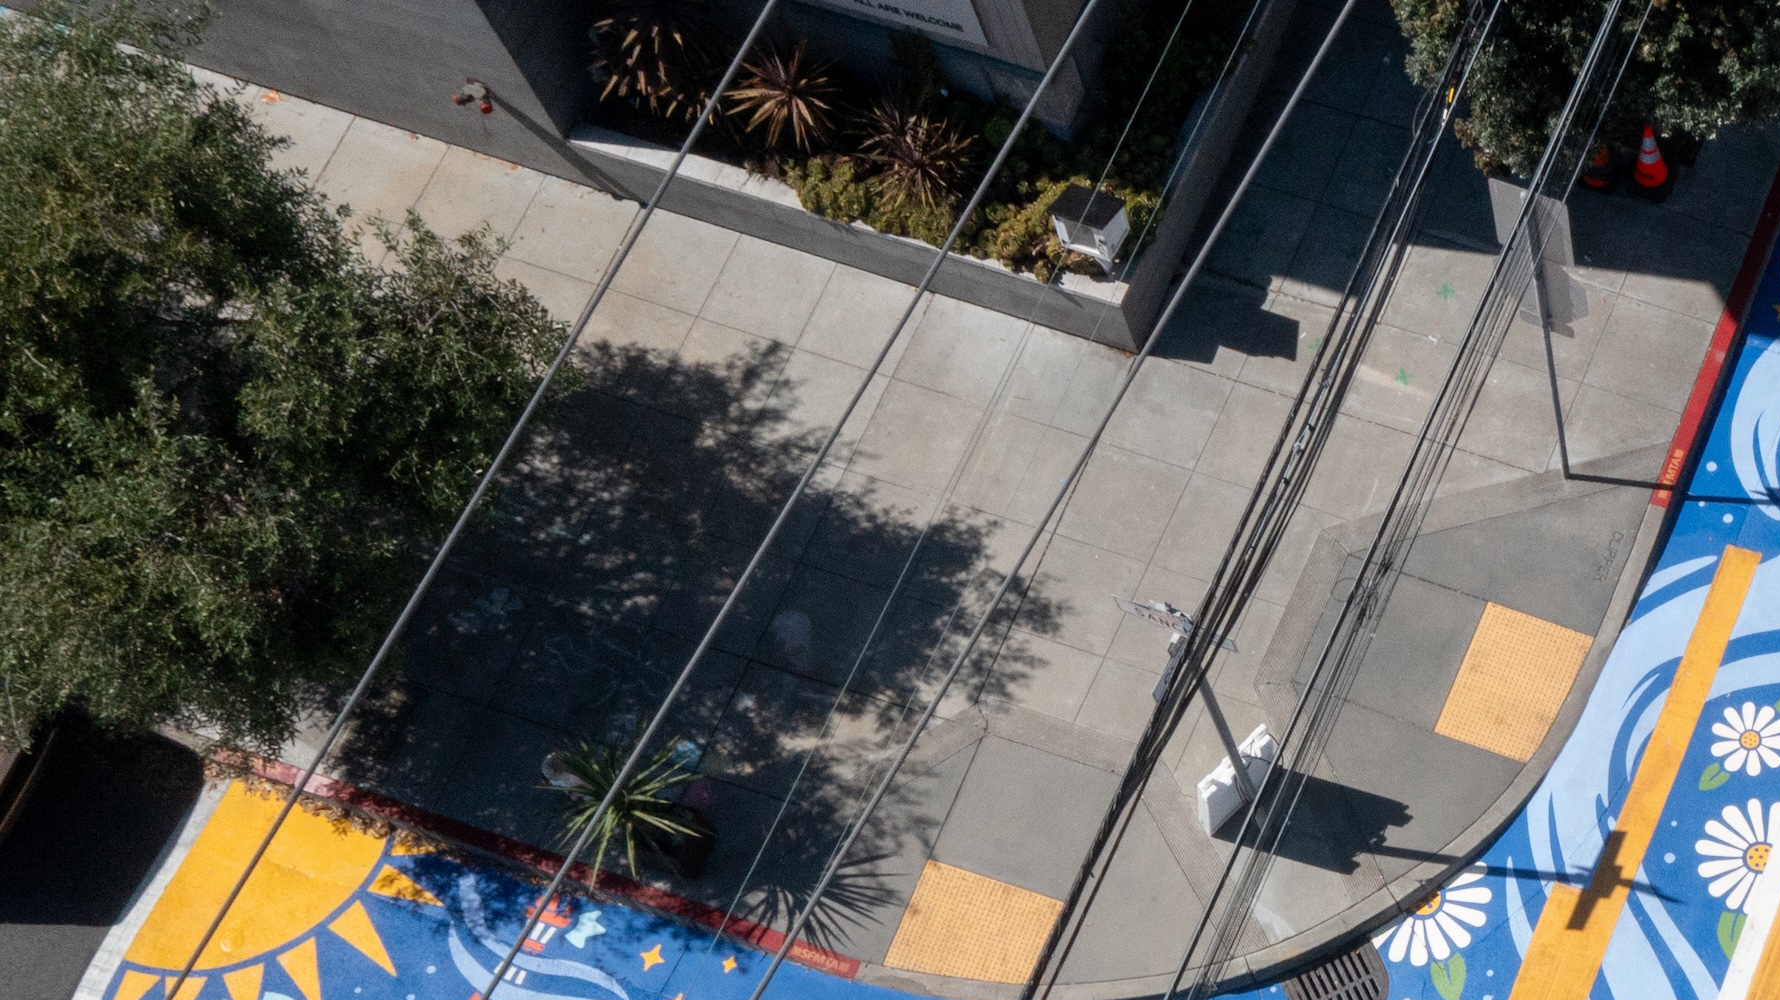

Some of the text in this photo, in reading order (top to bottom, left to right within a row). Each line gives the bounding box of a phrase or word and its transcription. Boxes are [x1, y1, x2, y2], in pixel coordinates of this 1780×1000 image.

[878, 3, 901, 15] ARE
[902, 9, 964, 32] WELCOME
[801, 948, 839, 971] SFMTA
